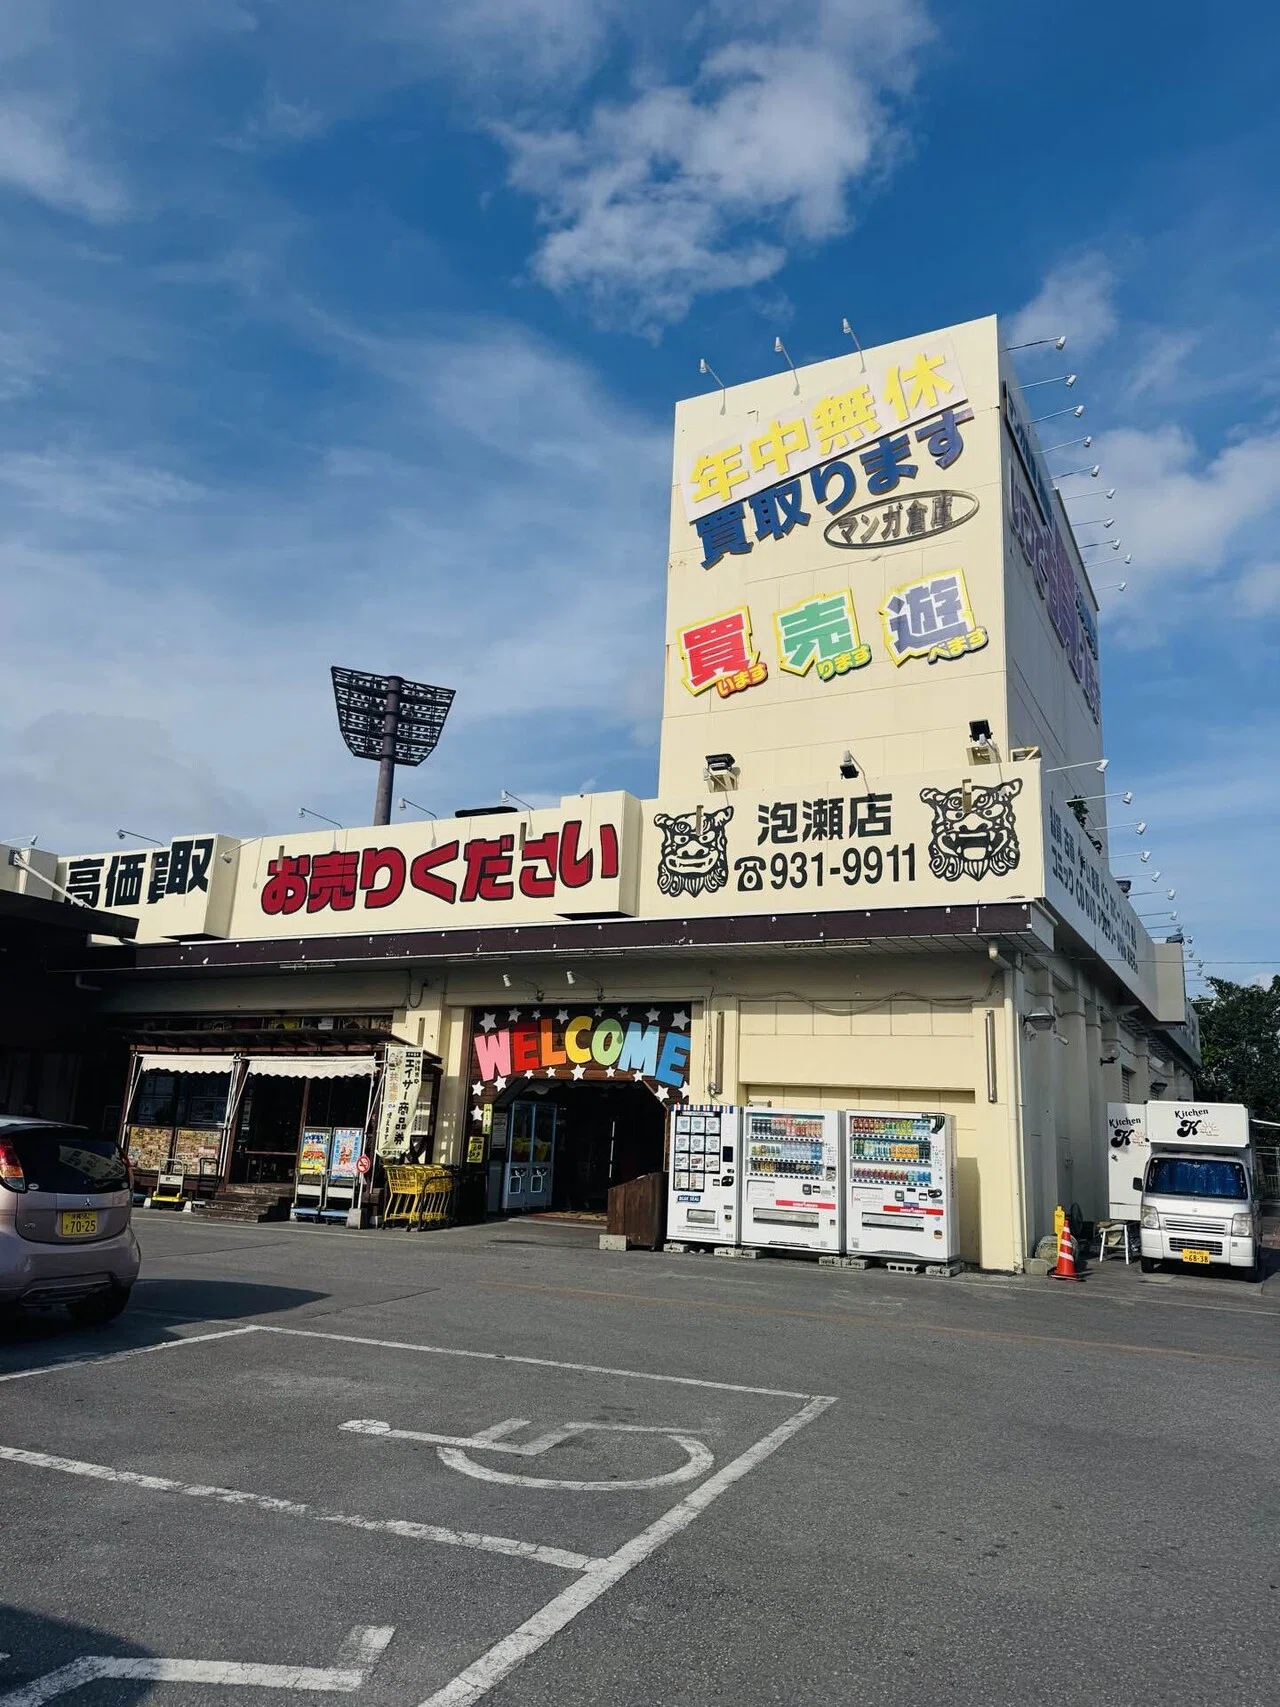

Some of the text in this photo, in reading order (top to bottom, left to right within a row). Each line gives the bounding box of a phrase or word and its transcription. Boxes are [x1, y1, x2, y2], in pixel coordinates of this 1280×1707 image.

[690, 352, 954, 503] 年中無休
[695, 408, 974, 569] 買取ります
[836, 490, 954, 544] マンガ倉庫
[781, 596, 853, 668] 売
[888, 577, 969, 657] 遊
[683, 615, 753, 688] 買
[816, 644, 872, 681] ります
[927, 627, 988, 665] べます
[715, 662, 769, 698] います
[757, 793, 893, 846] 泡瀬店
[260, 820, 618, 916] お売りください
[770, 843, 916, 889] 931-9911
[1051, 844, 1074, 896] コミック
[474, 1016, 691, 1087] WELCOME
[394, 1060, 415, 1145] エイサー商品券
[1108, 1117, 1142, 1128] Kitchen
[1174, 1108, 1209, 1119] Kitchen
[1176, 1119, 1202, 1138] K
[1110, 1128, 1135, 1148] K
